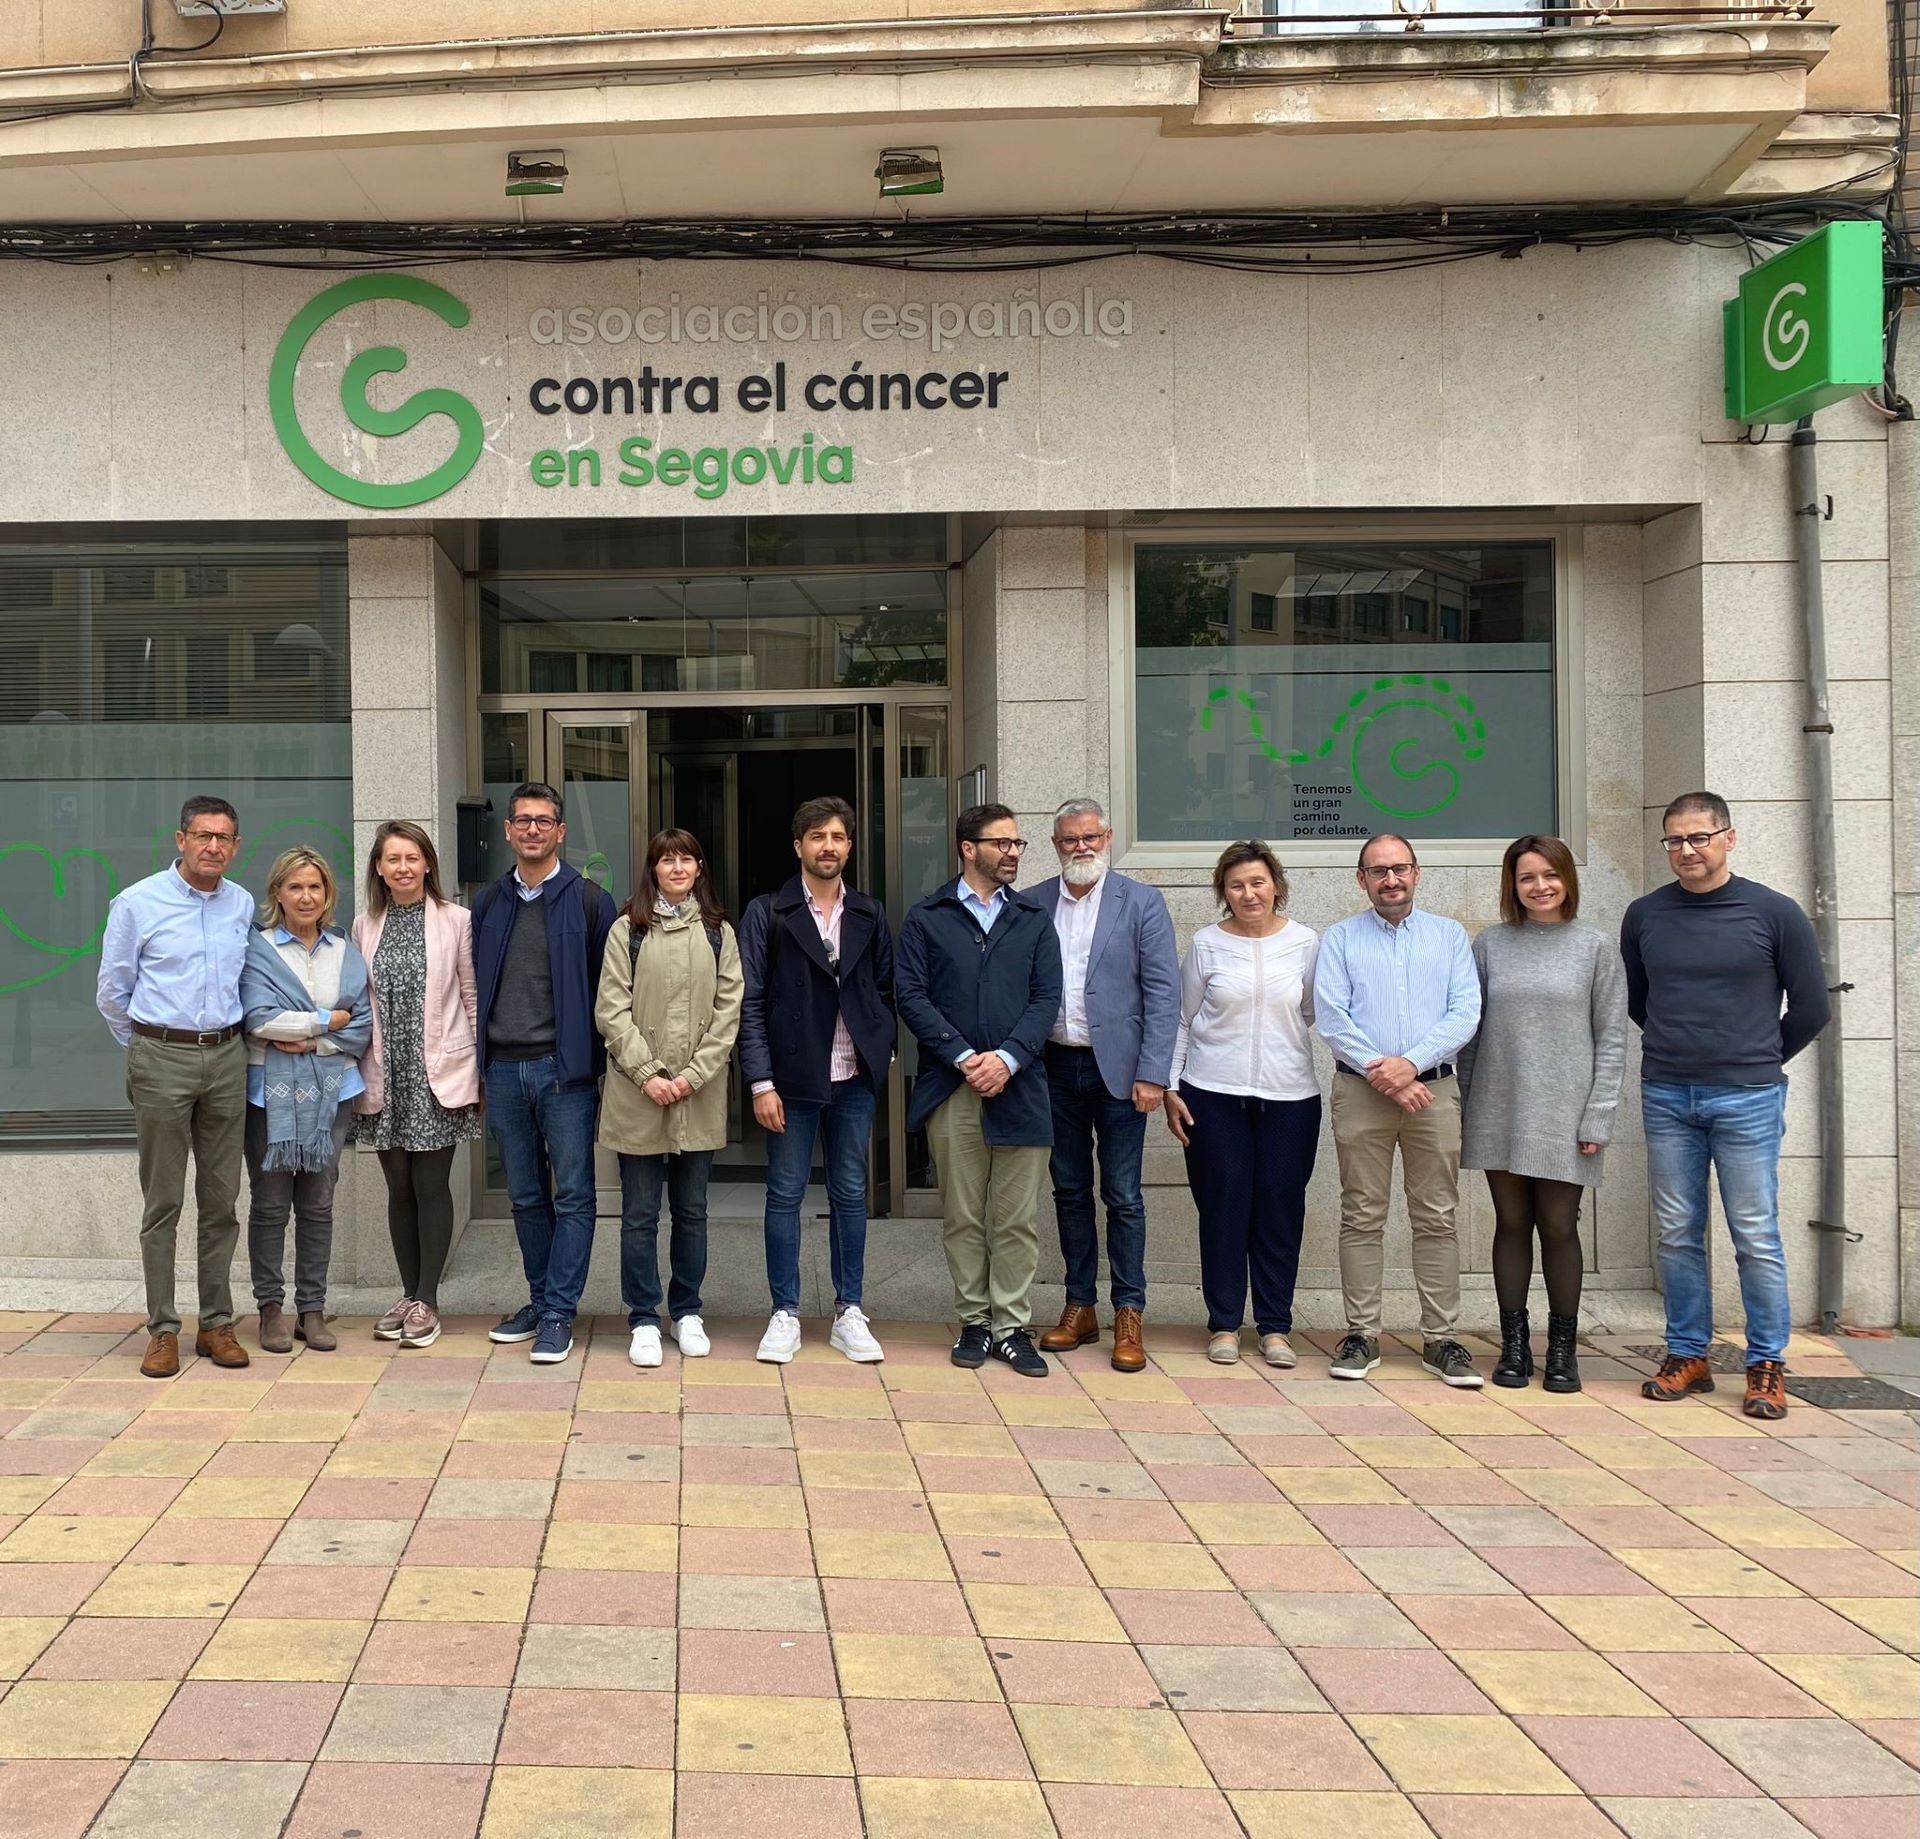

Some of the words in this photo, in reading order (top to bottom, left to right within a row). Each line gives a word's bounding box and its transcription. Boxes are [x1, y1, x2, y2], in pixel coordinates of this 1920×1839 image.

[528, 290, 843, 344] asociación
[862, 286, 1135, 350] española
[530, 366, 719, 415] contra
[737, 362, 786, 412] el
[804, 361, 1009, 412] cáncer
[529, 447, 601, 487] en
[618, 434, 854, 499] Segovia
[1293, 784, 1352, 794] Tenemos
[1293, 799, 1309, 808] un
[1312, 799, 1342, 810] gran
[1293, 811, 1340, 821] camino
[1293, 827, 1315, 837] por
[1318, 824, 1371, 835] delante.
